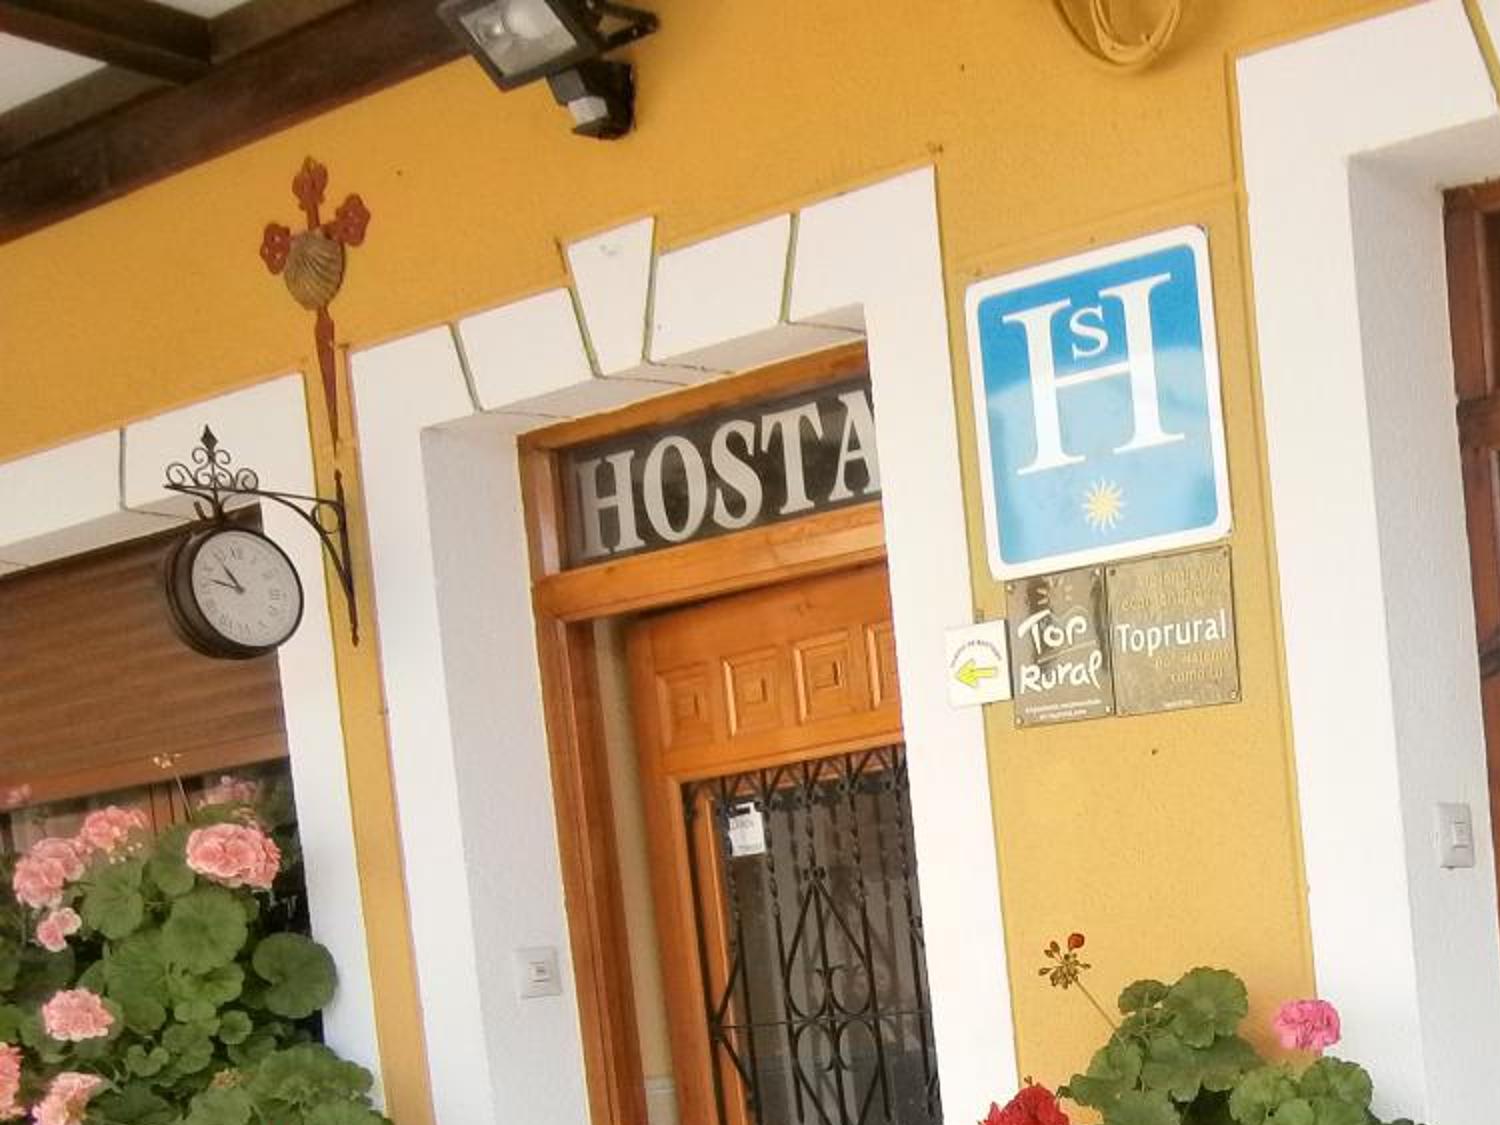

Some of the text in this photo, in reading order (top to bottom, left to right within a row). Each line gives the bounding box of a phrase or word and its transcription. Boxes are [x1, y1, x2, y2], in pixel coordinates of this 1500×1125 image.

[1017, 608, 1087, 655] Top
[1116, 608, 1227, 657] Toprural
[1020, 650, 1102, 695] Rural
